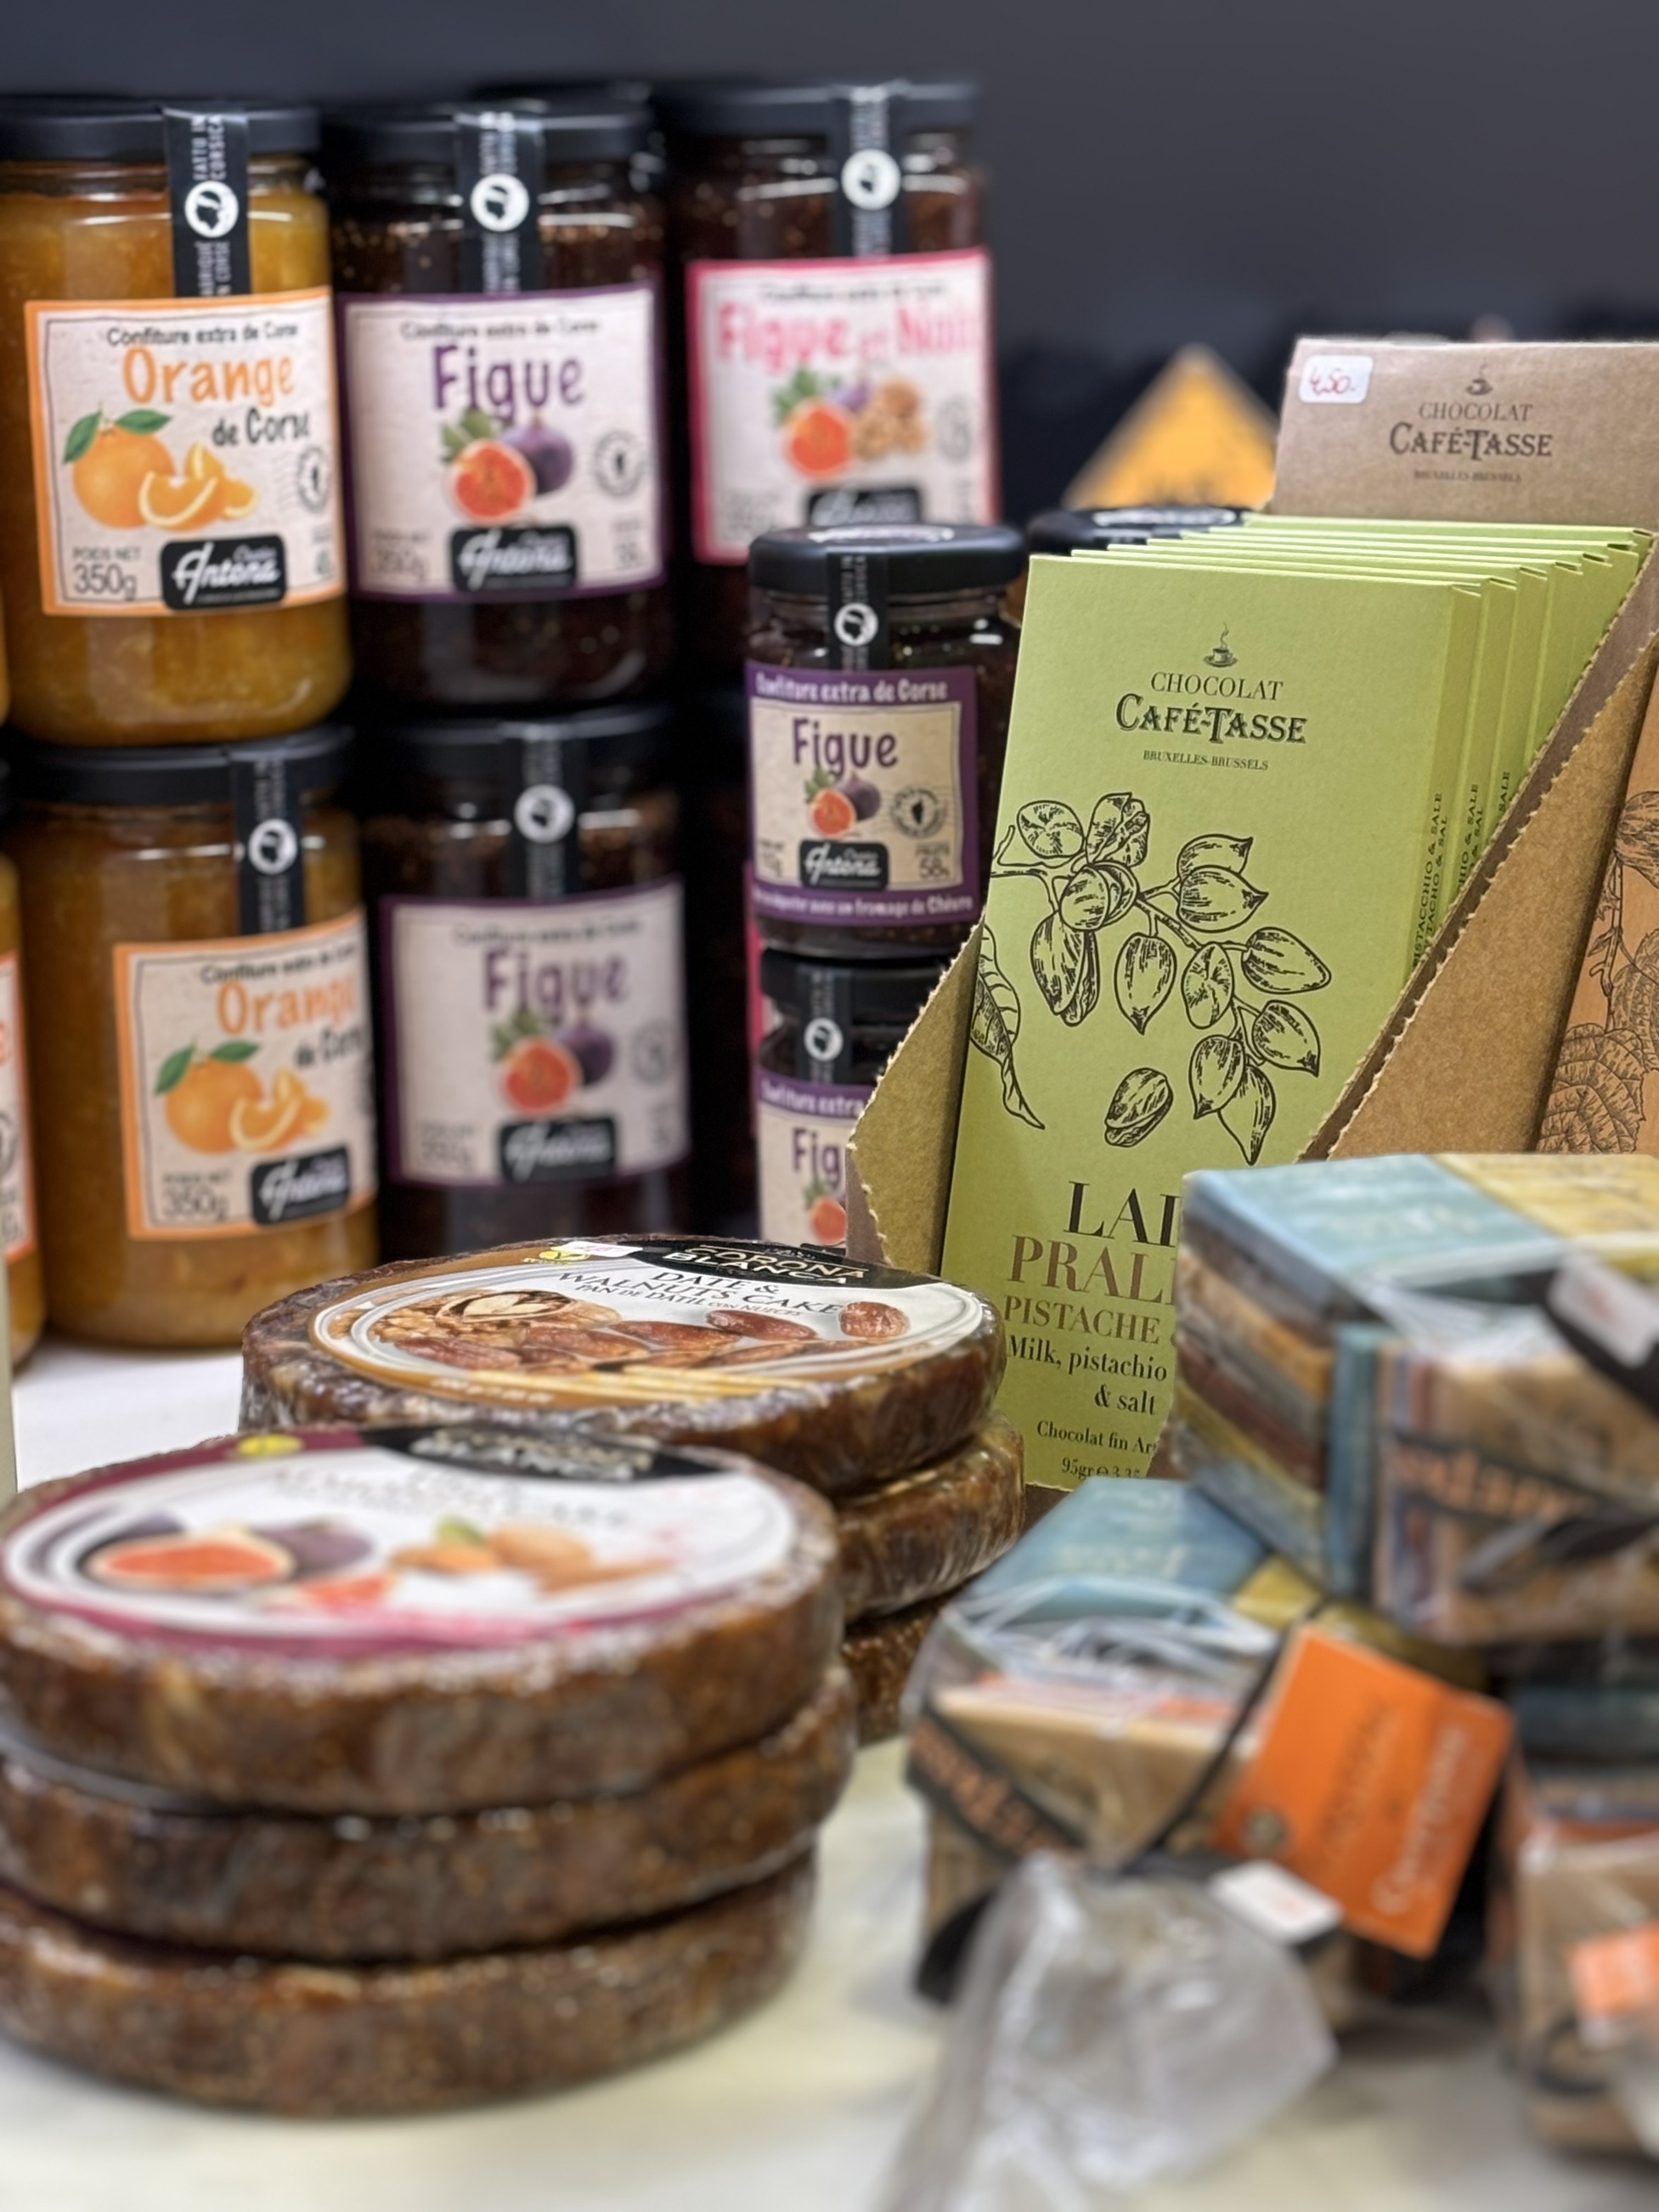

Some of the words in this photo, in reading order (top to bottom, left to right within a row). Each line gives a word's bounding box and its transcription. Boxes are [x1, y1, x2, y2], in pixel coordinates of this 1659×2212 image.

[107, 326, 189, 346] Confiture
[196, 327, 236, 343] extra
[122, 347, 294, 407] Orange
[432, 345, 584, 431] Figue
[1419, 402, 1533, 422] CHOCOLAT
[212, 416, 239, 446] de
[74, 563, 137, 601] 350g
[821, 681, 870, 702] extra
[874, 680, 894, 702] de
[1150, 672, 1284, 701] CHOCOLAT
[1116, 693, 1308, 745] CAFÉ-TASSE
[793, 718, 899, 775] Figue
[1143, 750, 1269, 771] BRUXELLES-BRUSSELS
[1430, 793, 1442, 835] SALE
[793, 1128, 840, 1189] Fig
[1063, 1180, 1180, 1248] LAI
[663, 1252, 846, 1285] BLANCA
[685, 1247, 864, 1279] CORONA
[1007, 1234, 1176, 1305] PRAL
[558, 1272, 737, 1300] WALNUTS
[742, 1294, 843, 1314] CAKE
[575, 1284, 617, 1294] PAN
[618, 1289, 643, 1297] DE
[652, 1271, 751, 1290] DATE
[754, 1285, 780, 1295] &
[1005, 1295, 1160, 1345] PISTACHE
[1008, 1334, 1062, 1369] Milk,
[1068, 1346, 1167, 1382] pistachio
[1094, 1383, 1112, 1409] &
[1116, 1390, 1156, 1416] salt
[1036, 1420, 1104, 1446] Chocolat
[1108, 1431, 1128, 1451] fin
